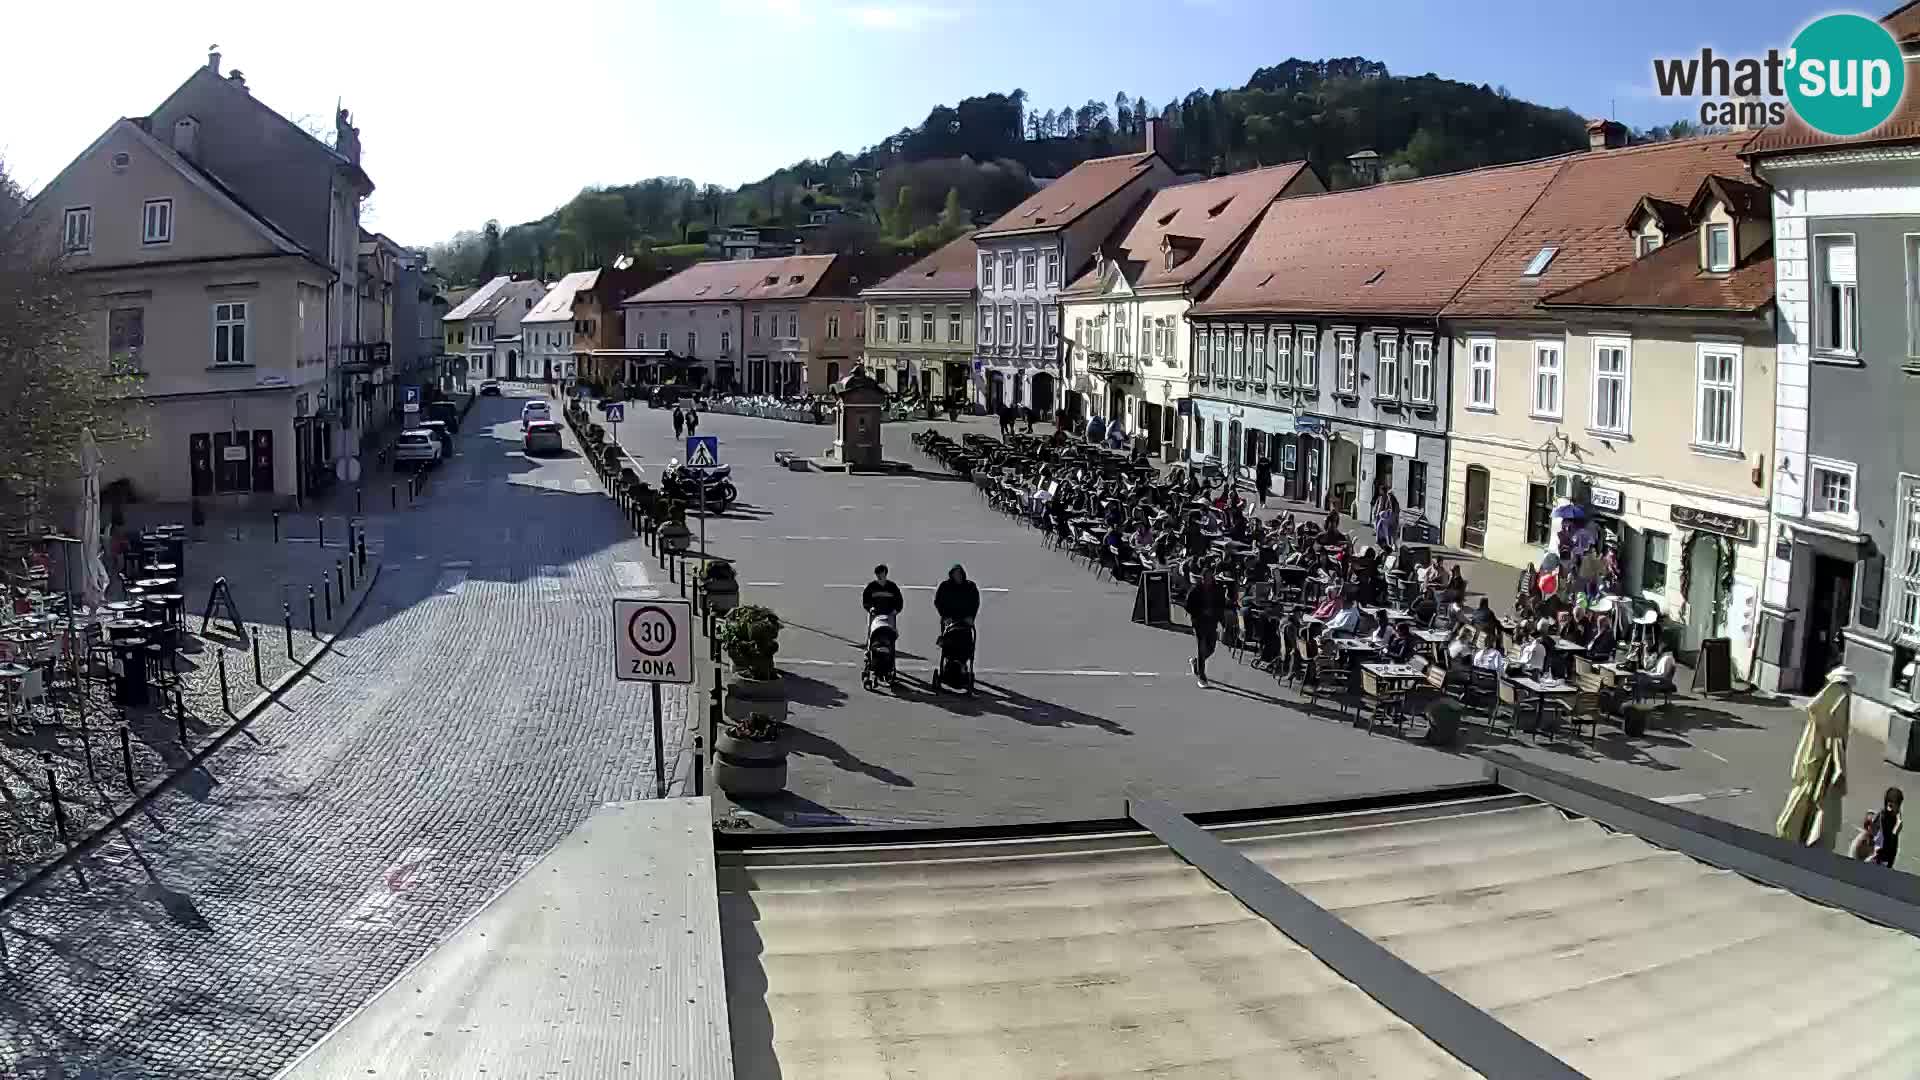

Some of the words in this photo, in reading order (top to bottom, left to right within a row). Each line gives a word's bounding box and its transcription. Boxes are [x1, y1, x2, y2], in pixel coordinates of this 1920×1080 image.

[407, 390, 416, 401] P
[641, 622, 665, 643] 30
[631, 660, 676, 677] ZONA
